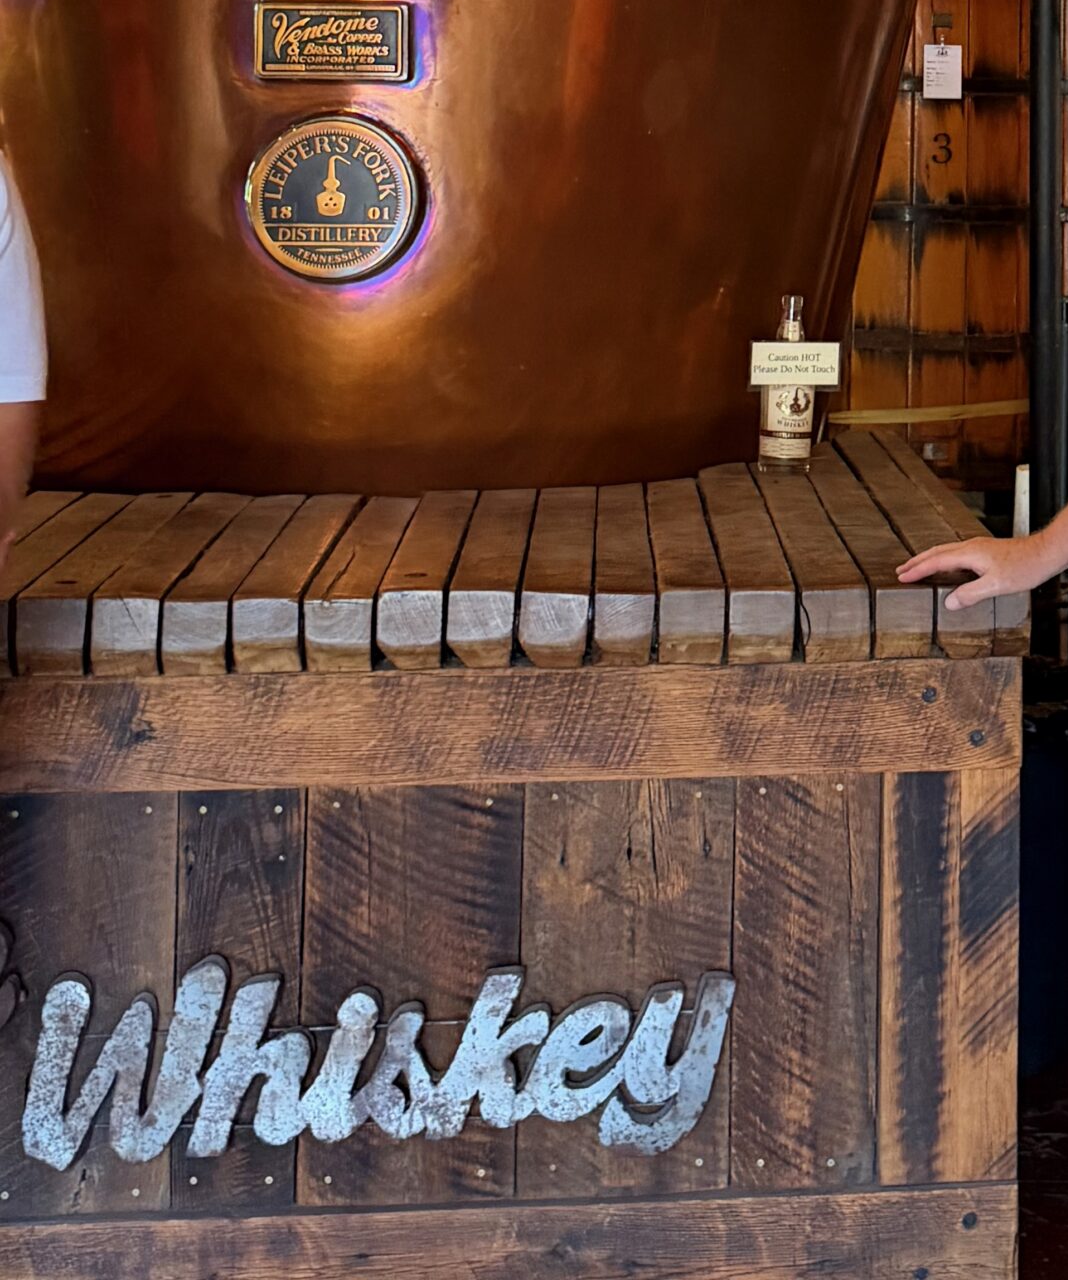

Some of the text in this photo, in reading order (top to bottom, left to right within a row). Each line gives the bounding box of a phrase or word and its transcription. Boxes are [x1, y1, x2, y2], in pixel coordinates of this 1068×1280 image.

[271, 12, 379, 59] Vendome
[339, 31, 382, 44] COPPER
[287, 41, 389, 57] & BRASS WORKS
[286, 55, 375, 63] INCORPORATED
[932, 133, 952, 164] 3
[264, 135, 396, 201] LEIPER'S FORK
[271, 206, 389, 220] 18 01
[278, 227, 381, 241] DISTILLERY
[297, 247, 363, 263] TENNESSEE
[768, 353, 821, 362] Caution HOT
[753, 365, 836, 373] Please Do Not Touch
[23, 954, 735, 1171] Whiskey
